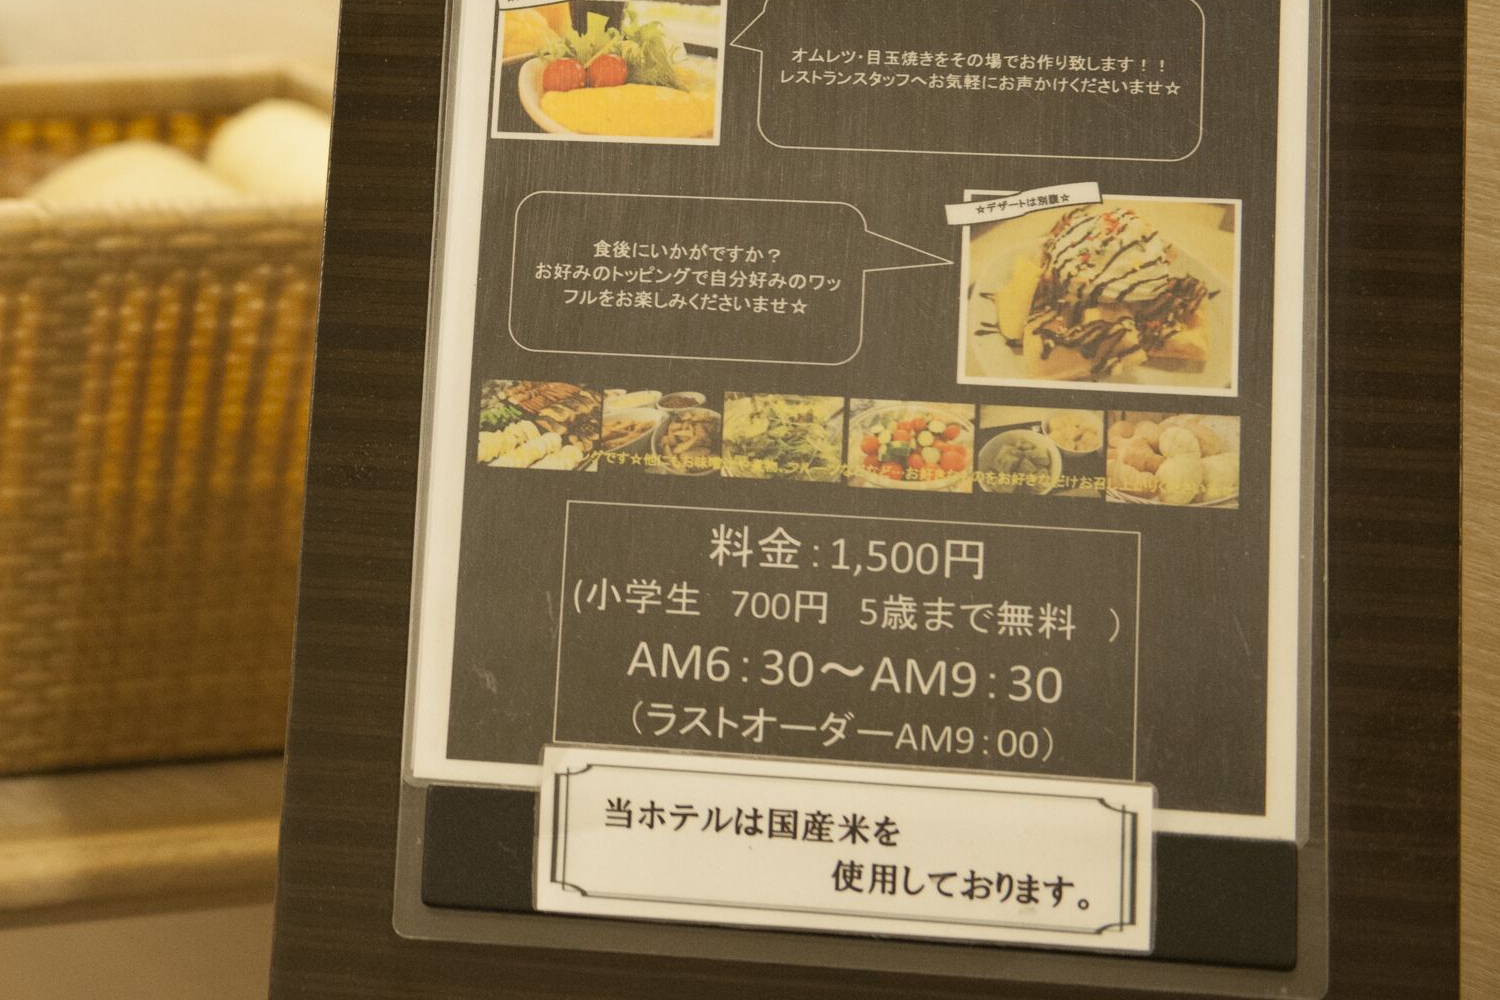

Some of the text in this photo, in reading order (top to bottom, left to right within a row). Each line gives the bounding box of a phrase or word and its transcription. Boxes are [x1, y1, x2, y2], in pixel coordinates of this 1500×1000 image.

[534, 262, 841, 291] お好みのトッピングで自分好みのワッ
[593, 239, 781, 264] 食後にいかがですか？
[731, 589, 829, 625] 700円
[859, 594, 1077, 642] 5歳まで無料
[603, 797, 902, 848] 当ホテルは国産米を
[831, 859, 1092, 911] 使用しております。
